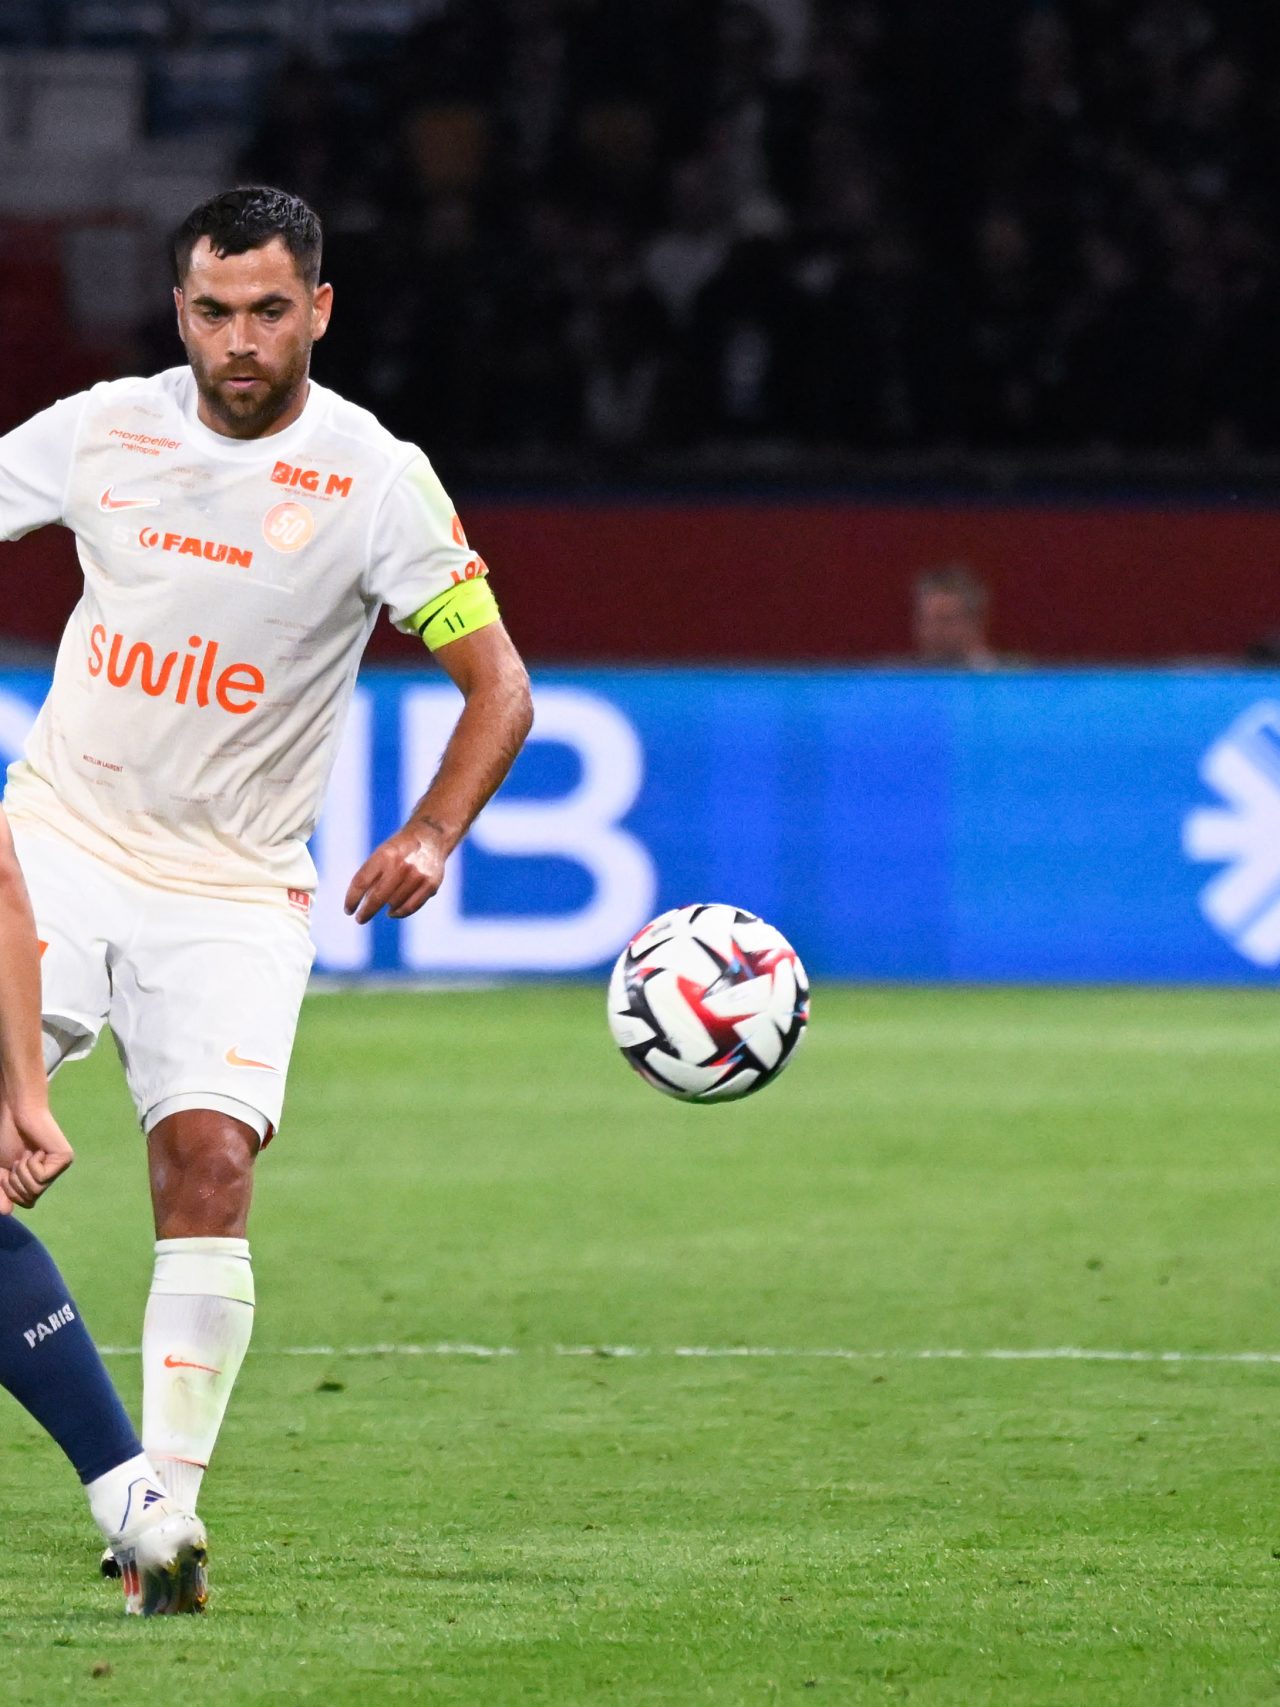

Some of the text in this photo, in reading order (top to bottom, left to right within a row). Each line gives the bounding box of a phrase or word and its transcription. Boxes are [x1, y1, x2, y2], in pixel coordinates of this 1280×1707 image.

[271, 461, 320, 492] BIG
[325, 474, 353, 497] M
[162, 532, 254, 568] FAUN
[443, 611, 465, 634] 11
[88, 623, 265, 715] swile
[23, 1303, 75, 1349] PARIS
